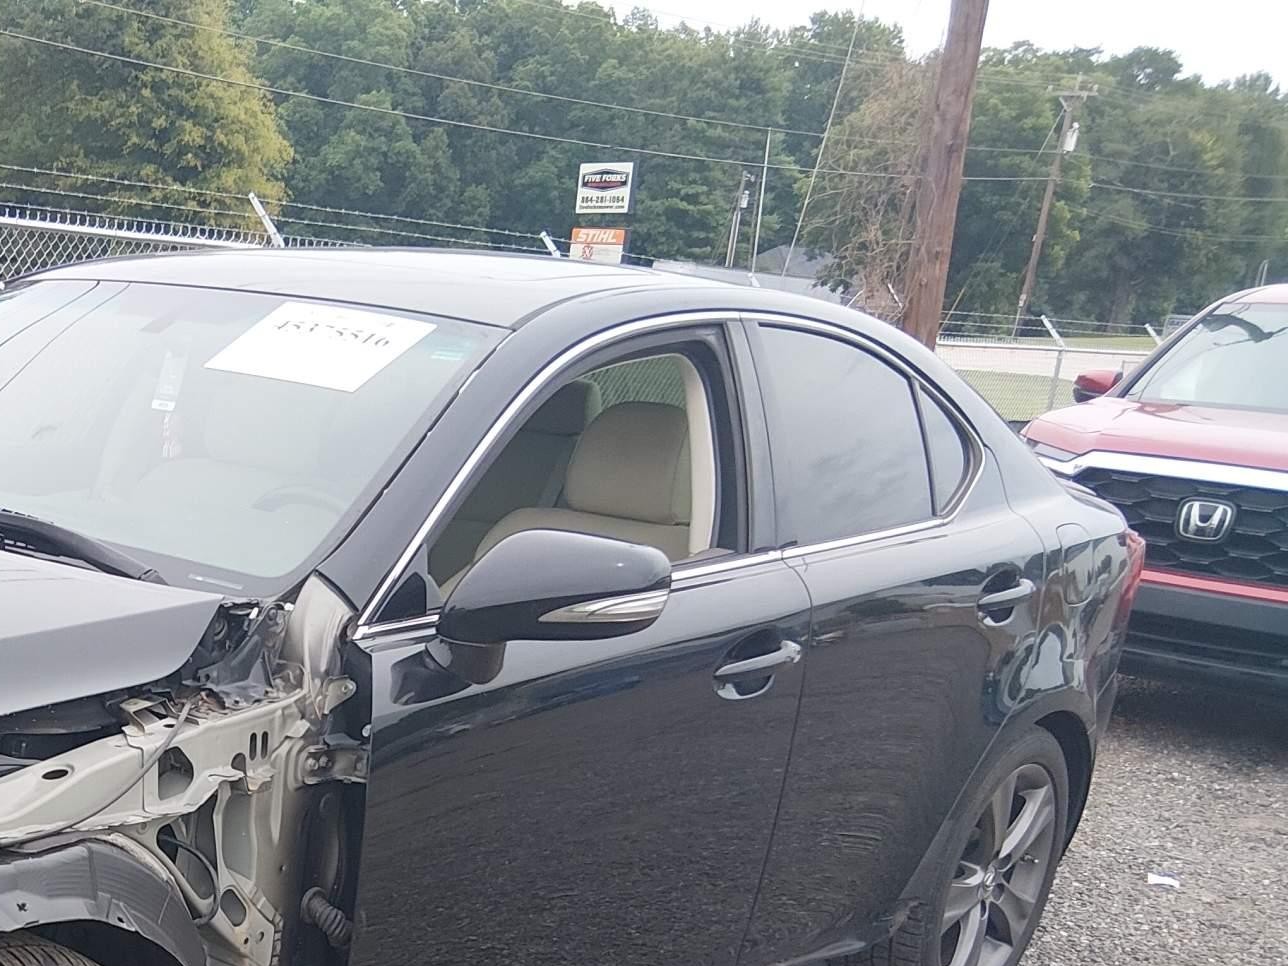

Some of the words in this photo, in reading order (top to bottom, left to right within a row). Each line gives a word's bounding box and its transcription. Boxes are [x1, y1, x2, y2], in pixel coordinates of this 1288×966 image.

[584, 174, 601, 183] FIVE
[602, 173, 626, 182] FORKS
[576, 230, 616, 242] STIHL
